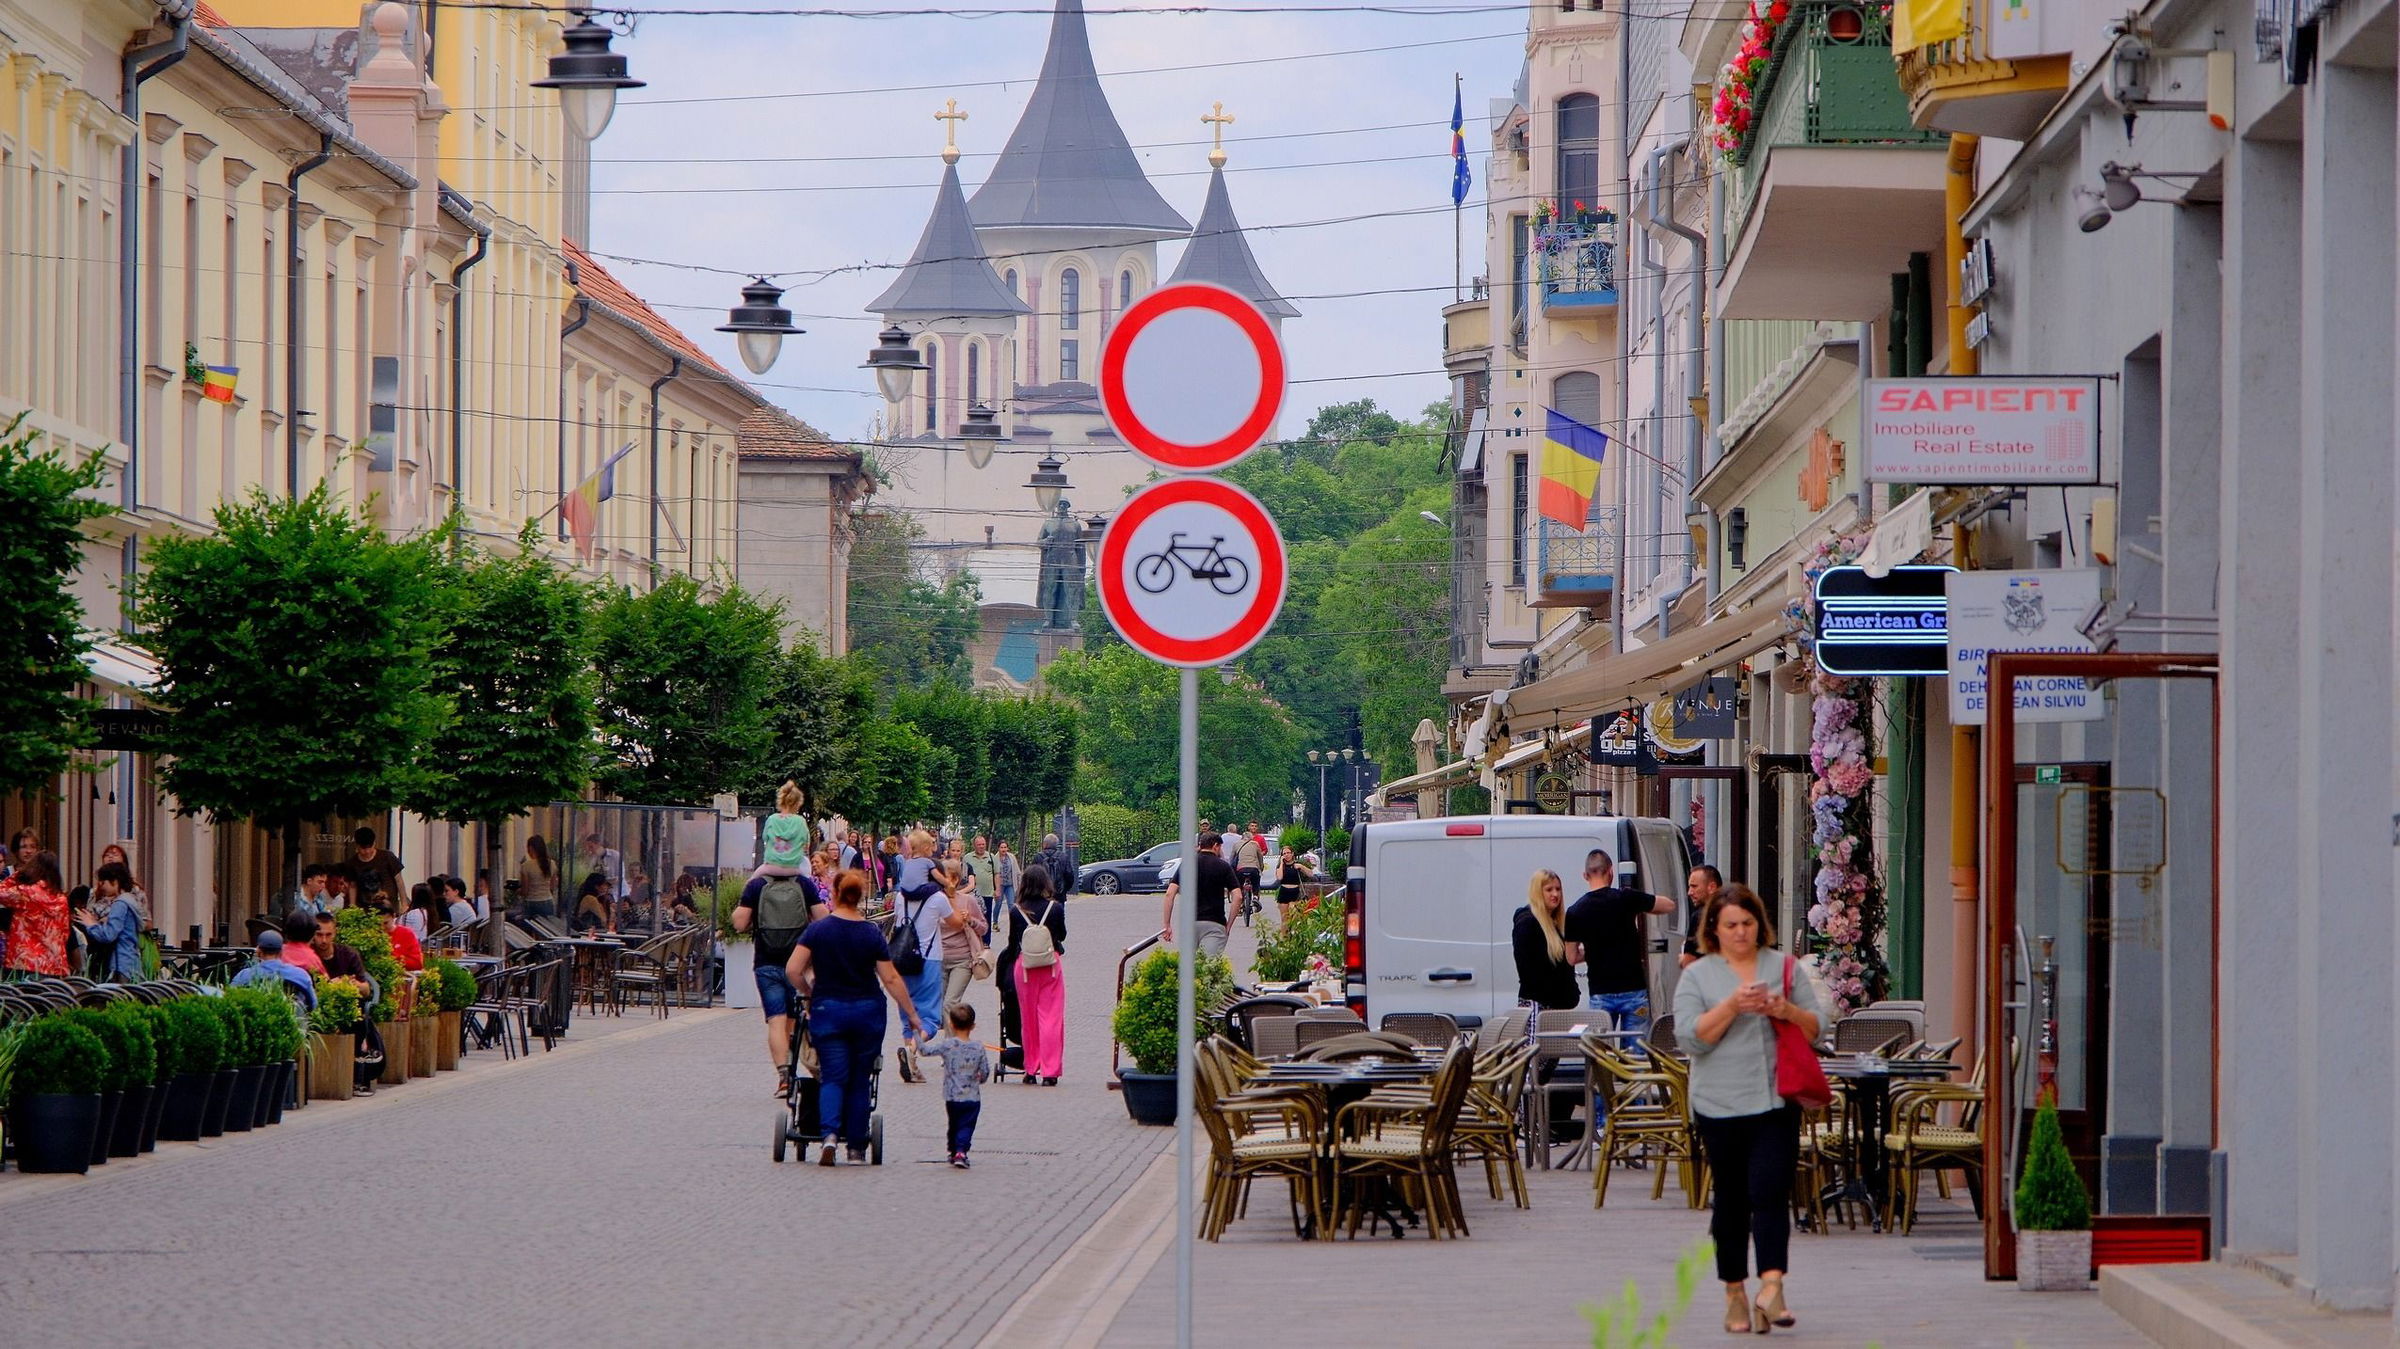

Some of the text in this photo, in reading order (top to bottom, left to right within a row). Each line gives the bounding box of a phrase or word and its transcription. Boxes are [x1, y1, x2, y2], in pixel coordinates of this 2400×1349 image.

[1876, 388, 2087, 412] SAPIENT
[1874, 422, 1976, 435] Imobiliare
[1913, 440, 2035, 454] Real Estate
[1874, 463, 2089, 475] www.sapientimobiliare.com
[1820, 612, 1918, 629] American
[1959, 678, 2086, 693] DEHAN CORNE
[1676, 699, 1733, 712] VNUE
[1966, 695, 2086, 710] DEEAN SILVIU
